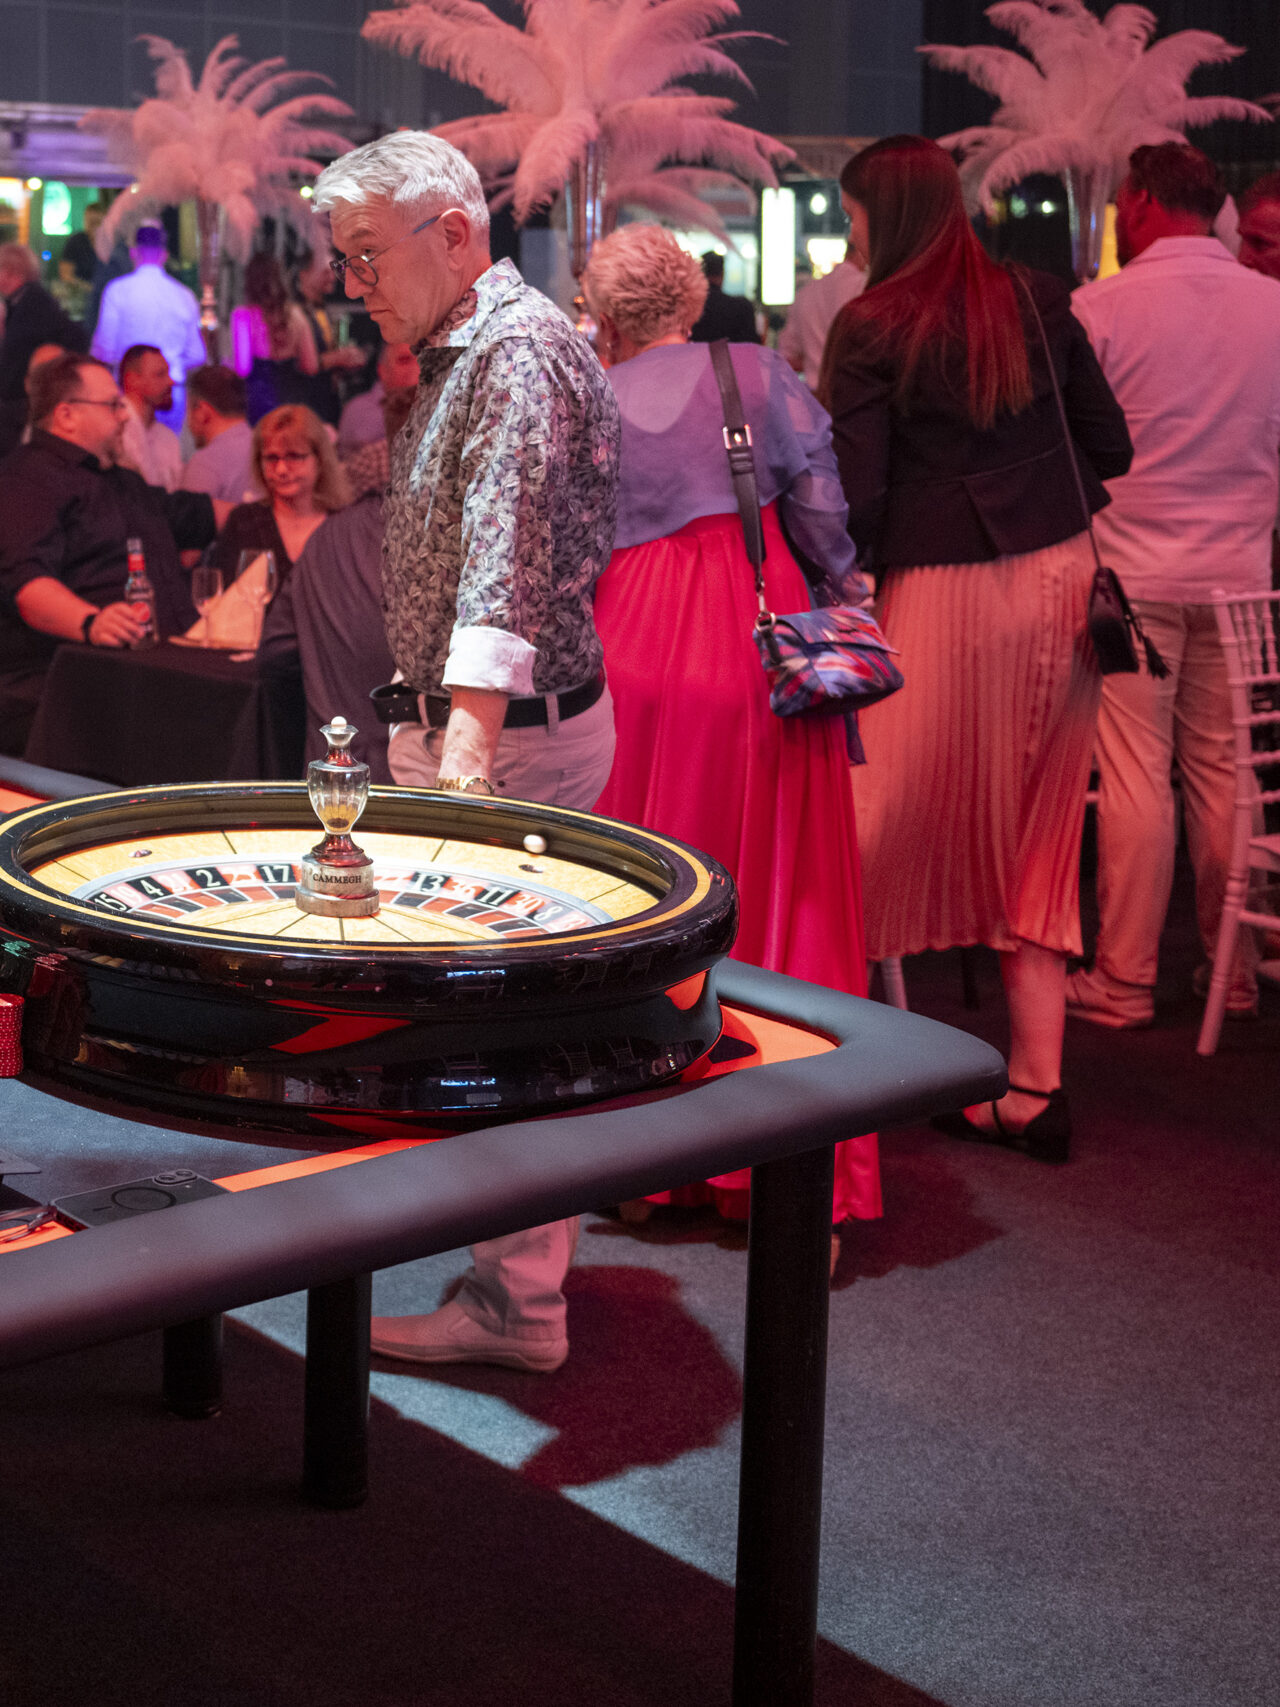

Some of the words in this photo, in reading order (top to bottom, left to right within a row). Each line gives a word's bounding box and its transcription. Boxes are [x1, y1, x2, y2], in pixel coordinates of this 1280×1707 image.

[195, 869, 222, 887] 2
[260, 865, 290, 883] 17
[312, 873, 362, 884] CAMMEGH
[412, 874, 446, 892] 13
[140, 879, 165, 897] 4
[478, 886, 514, 906] 11
[94, 893, 128, 912] 15
[533, 905, 564, 921] 8
